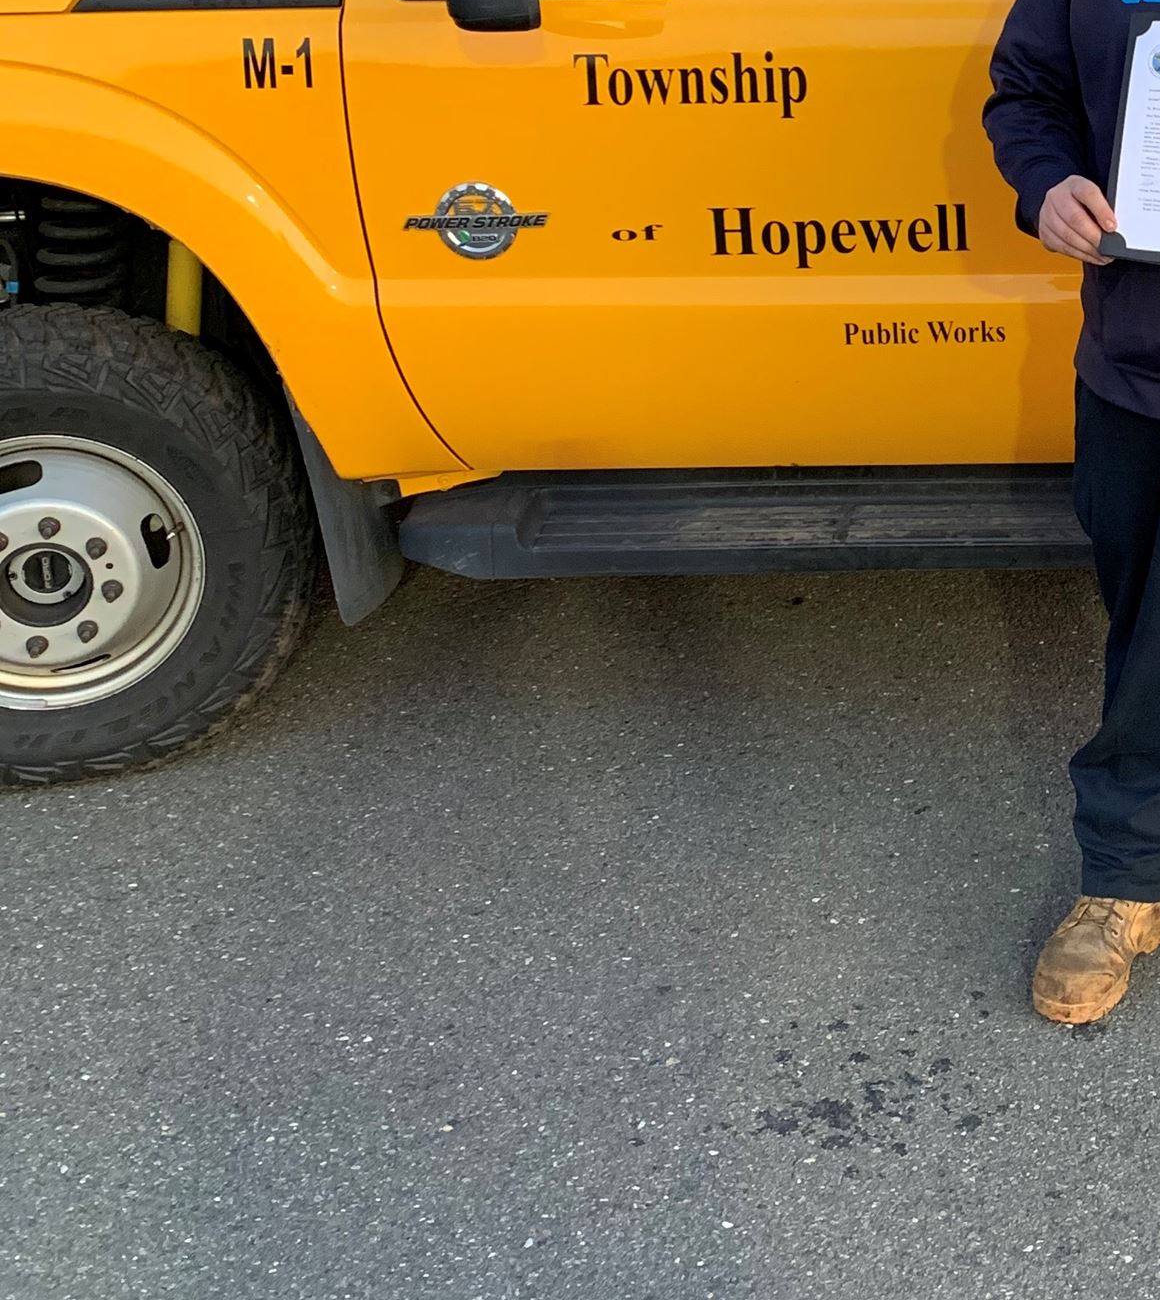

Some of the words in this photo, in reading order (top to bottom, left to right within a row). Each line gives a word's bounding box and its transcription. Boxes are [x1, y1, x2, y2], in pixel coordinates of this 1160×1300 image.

[242, 37, 313, 89] M-1
[573, 51, 808, 118] Township
[404, 216, 468, 230] POWER
[472, 214, 548, 229] STROKE
[611, 224, 663, 241] of
[707, 204, 971, 268] Hopewell
[844, 322, 919, 345] Public
[927, 320, 1006, 343] Works
